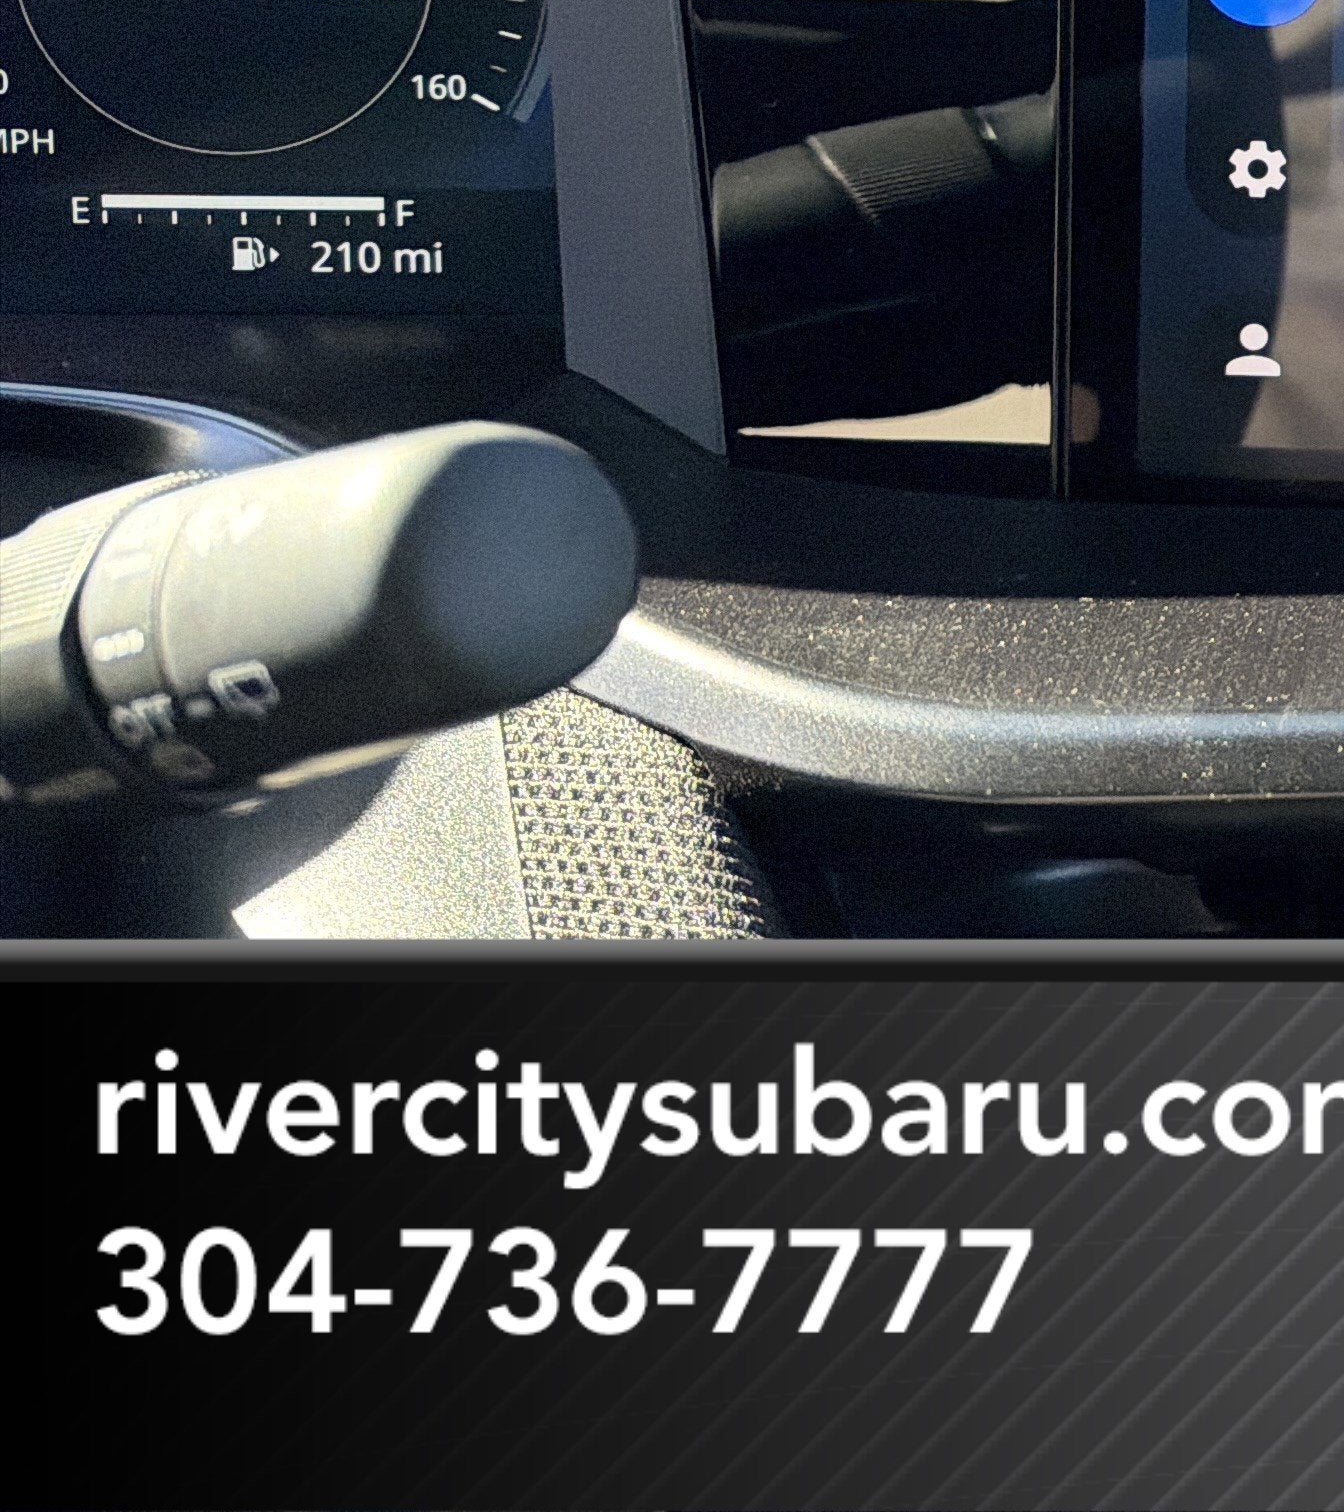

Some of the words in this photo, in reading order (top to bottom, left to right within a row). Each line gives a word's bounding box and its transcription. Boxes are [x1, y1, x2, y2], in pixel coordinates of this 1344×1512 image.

[411, 73, 467, 102] 160
[0, 128, 55, 155] PH
[71, 196, 91, 225] E
[395, 199, 415, 228] F
[310, 241, 382, 275] 210
[394, 240, 443, 275] mi
